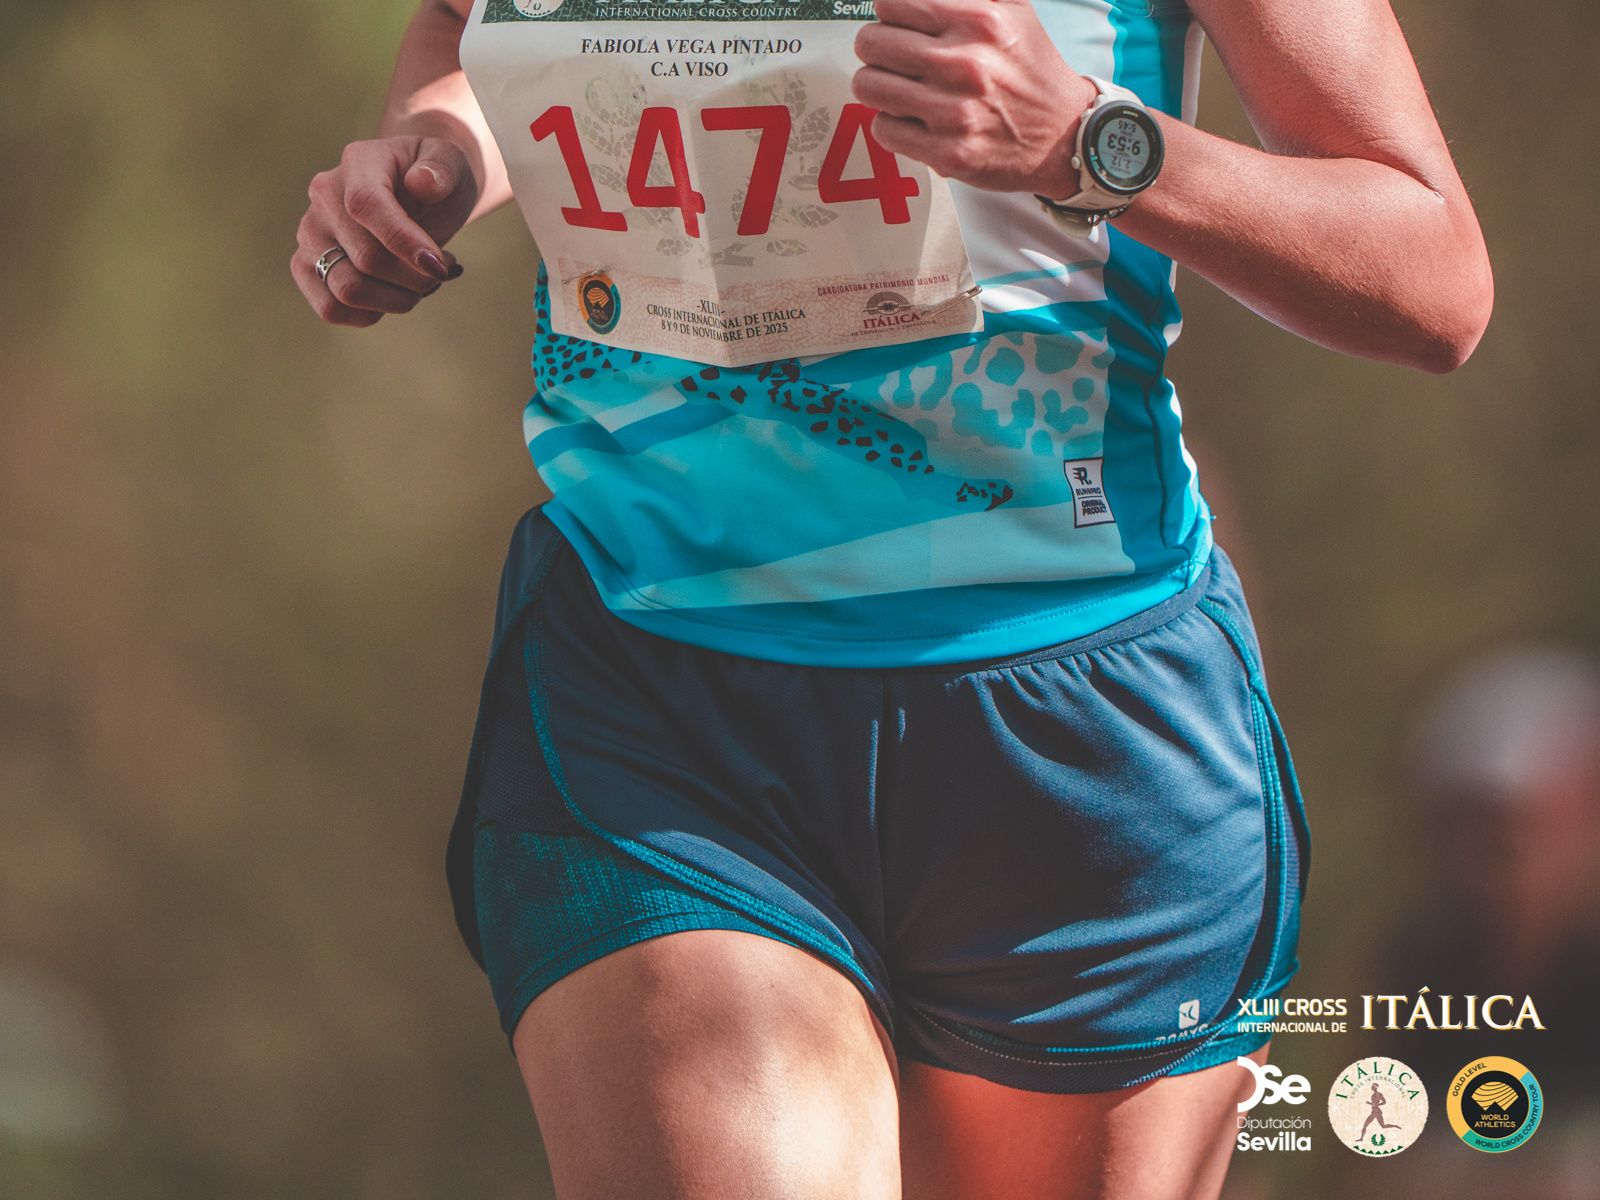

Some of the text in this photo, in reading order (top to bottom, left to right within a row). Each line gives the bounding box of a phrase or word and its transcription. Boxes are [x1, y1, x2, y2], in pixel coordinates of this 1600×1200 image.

[595, 7, 800, 17] INTERNATIONAL CROSS COUNTRY
[833, 1, 877, 16] Sevill
[581, 38, 802, 54] FABIOLA VEGA PINTADO
[650, 61, 728, 77] C.A VISO
[1107, 133, 1141, 156] 9:53
[529, 102, 920, 238] 1474
[817, 274, 950, 297] CANDIDATURA PATRIMONIO MUNDIAL
[646, 303, 672, 319] CROSS
[673, 308, 742, 330] INTERNACIONAL
[744, 313, 760, 326] DE
[863, 312, 921, 329] ITÁLICA
[661, 319, 788, 342] 8 Y 9 DE NOVIEMBRE DE 2025
